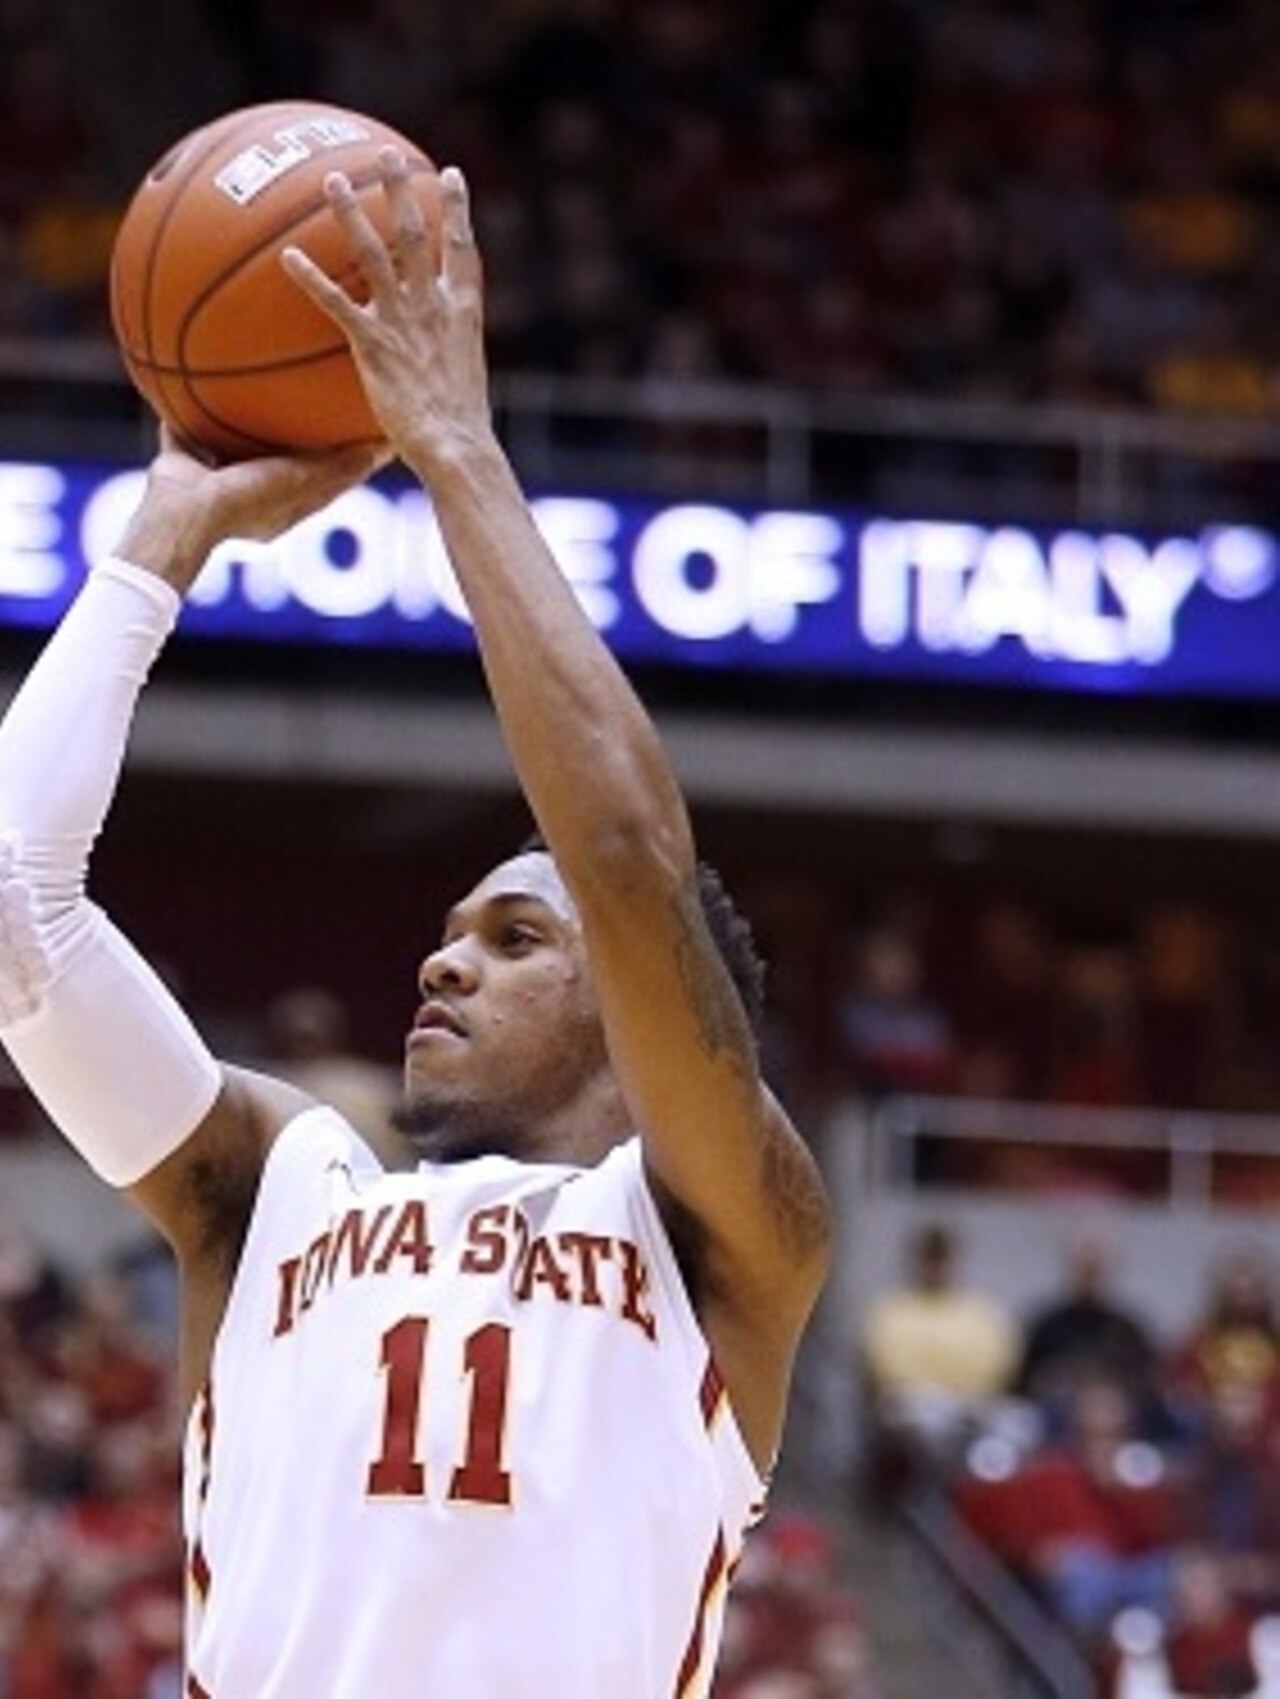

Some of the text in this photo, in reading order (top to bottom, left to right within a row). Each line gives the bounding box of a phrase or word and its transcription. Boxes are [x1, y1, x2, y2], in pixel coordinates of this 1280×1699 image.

[80, 470, 618, 633] COIE
[632, 505, 843, 643] OF
[272, 1199, 437, 1338] IOWA
[365, 1313, 515, 1509] 11
